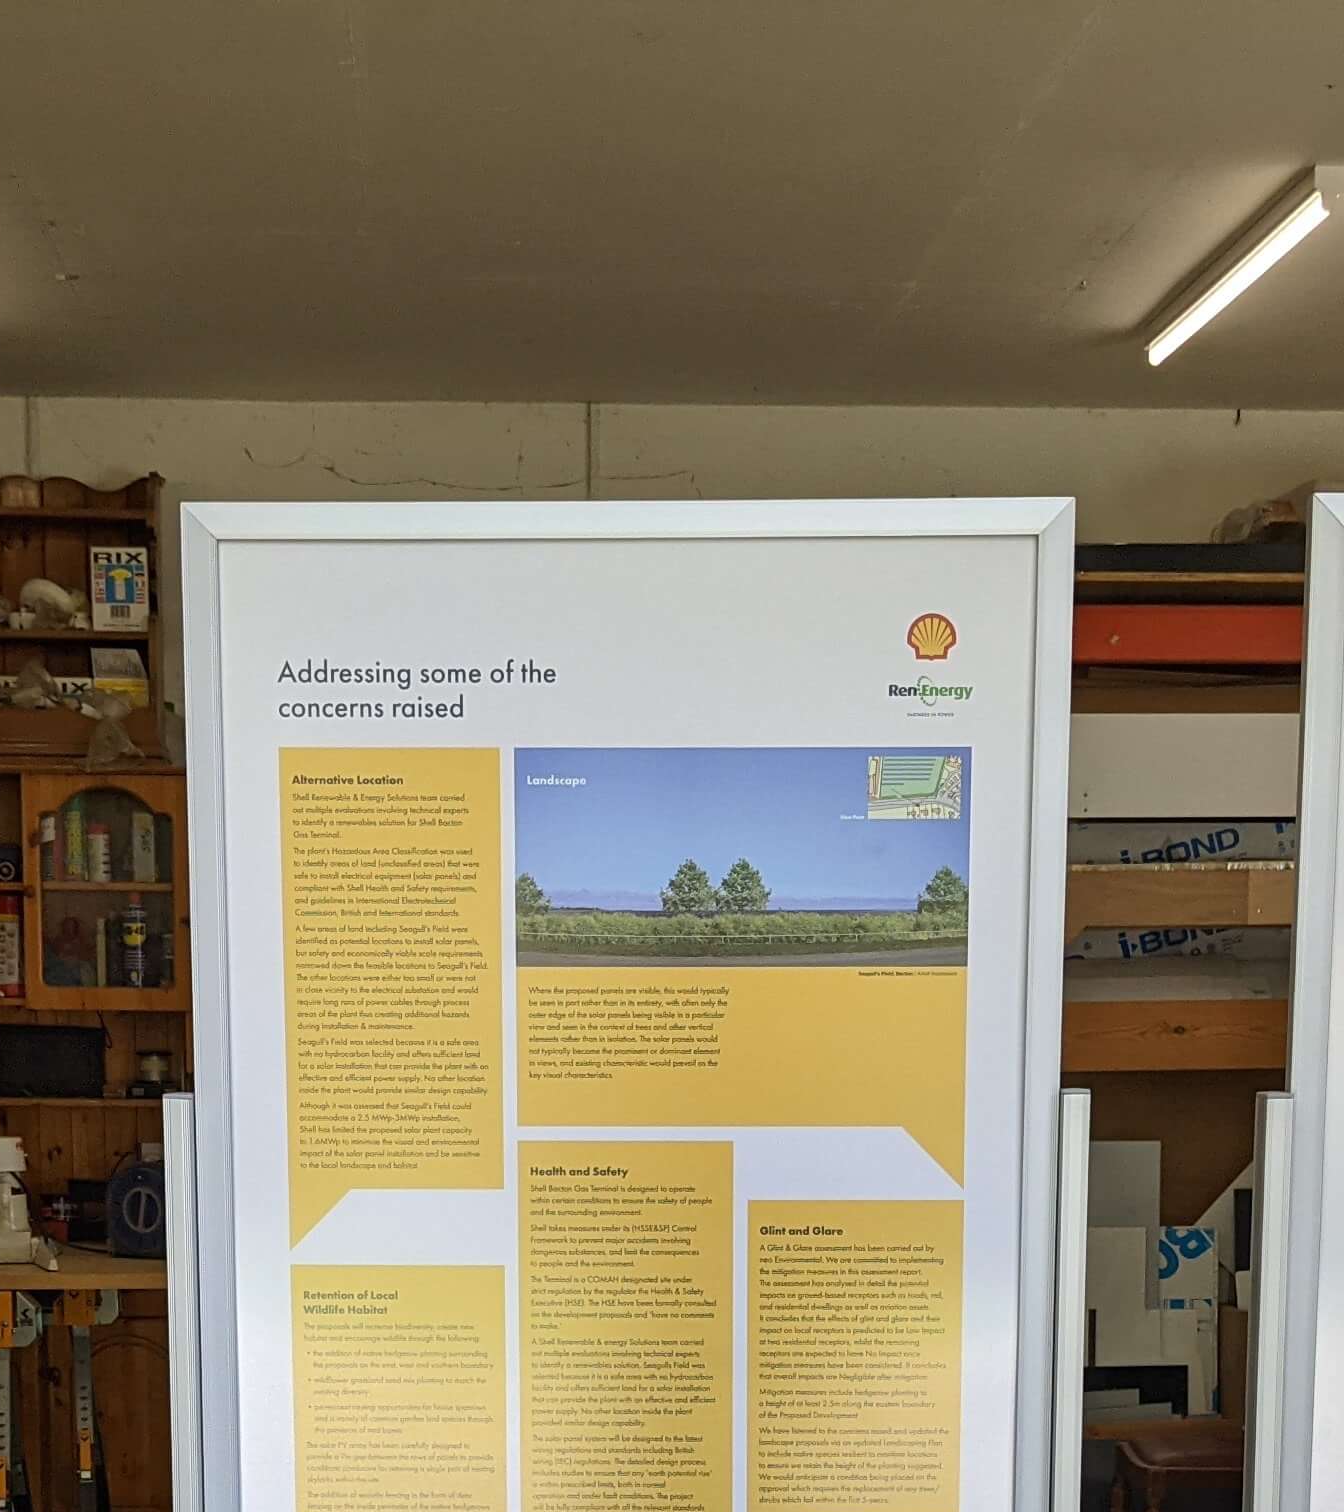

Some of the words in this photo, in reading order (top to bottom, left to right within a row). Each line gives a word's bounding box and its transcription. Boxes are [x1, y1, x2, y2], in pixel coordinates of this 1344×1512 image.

[94, 552, 143, 564] RIX
[277, 658, 412, 691] Addressing
[420, 668, 482, 684] some
[489, 658, 515, 684] of
[520, 658, 557, 684] the
[278, 702, 385, 718] concerns
[392, 693, 464, 719] raised
[291, 773, 355, 785] Alternative
[356, 773, 404, 785] Location
[526, 774, 587, 788] Landscape
[529, 1165, 567, 1177] Health
[568, 1165, 591, 1177] and
[592, 1165, 629, 1180] Safety
[759, 1225, 787, 1236] Glint
[787, 1225, 810, 1236] and
[812, 1225, 844, 1236] Glare
[303, 1289, 355, 1300] Retention
[356, 1289, 369, 1301] of
[370, 1289, 399, 1301] Local
[302, 1303, 345, 1315] Wildlife
[347, 1304, 388, 1315] Habitat
